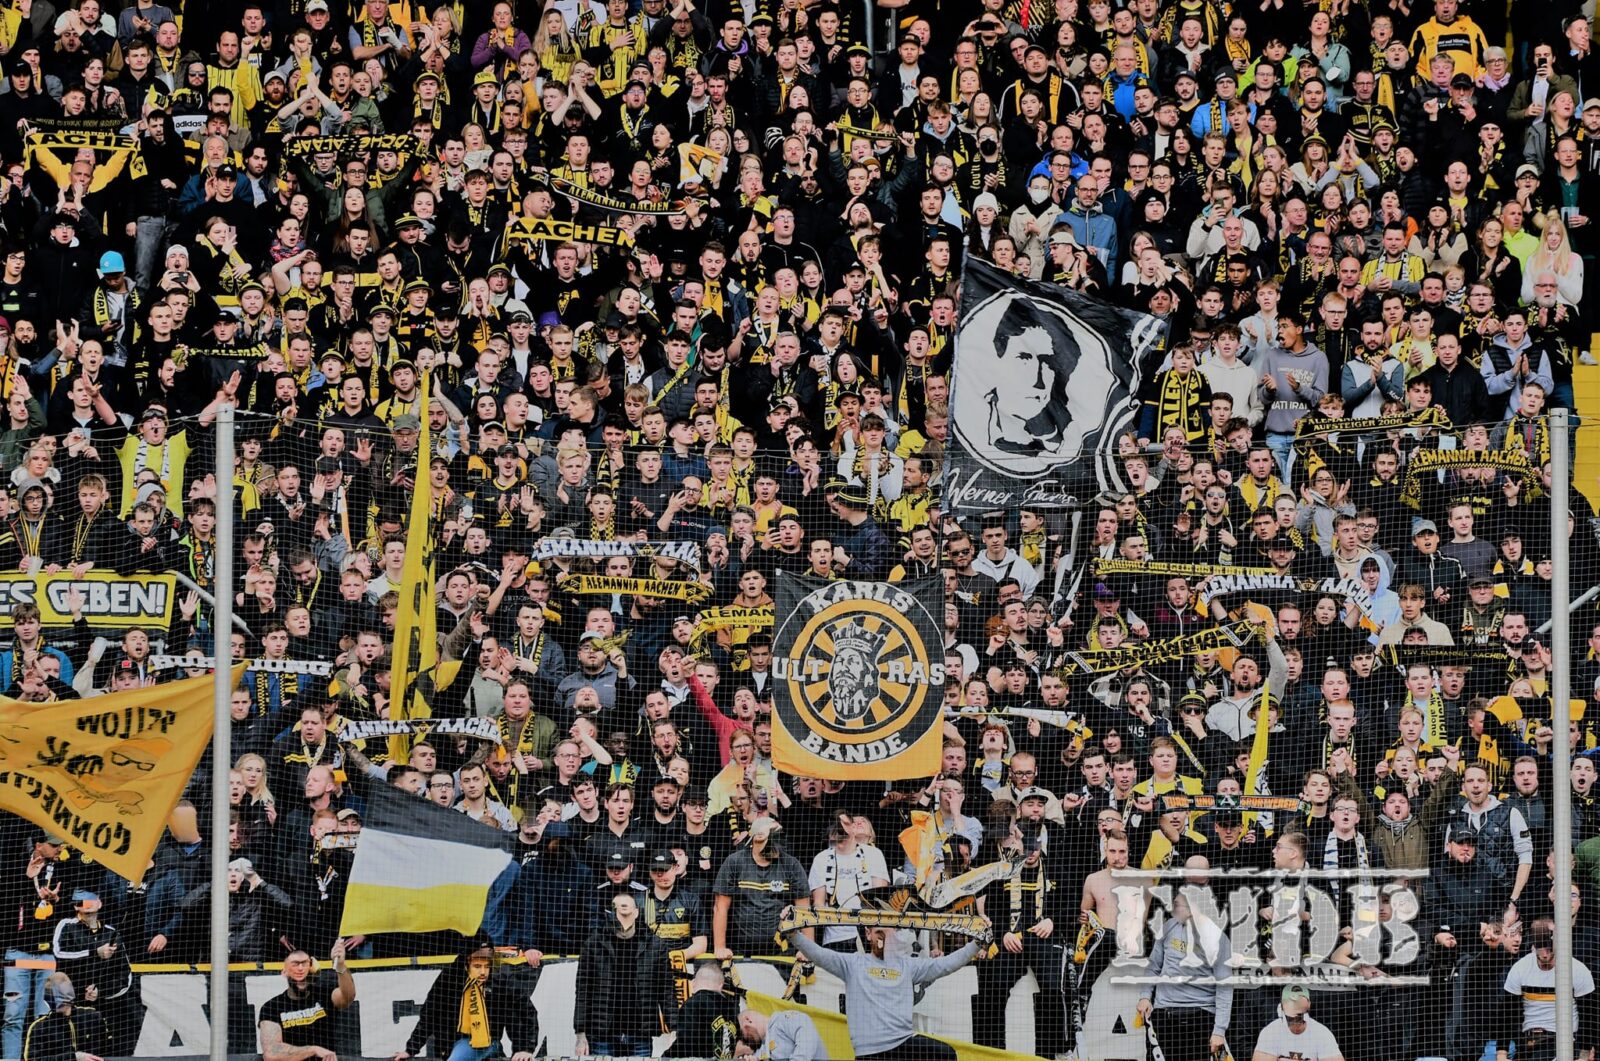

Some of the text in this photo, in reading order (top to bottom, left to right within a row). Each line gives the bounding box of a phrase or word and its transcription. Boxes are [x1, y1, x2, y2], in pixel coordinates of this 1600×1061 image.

[568, 186, 669, 211] ALEMANNIA AACHEN
[509, 221, 636, 248] AACHEN
[1313, 420, 1376, 431] AUFSTEIGER
[948, 467, 1013, 507] Werner
[48, 582, 166, 613] GEBEN!
[586, 577, 682, 596] ALEMANNIA AACHEN
[807, 582, 914, 613] KARLS
[1472, 652, 1508, 660] AACHEN
[772, 657, 945, 686] ULT RAS
[801, 732, 907, 763] BANDE
